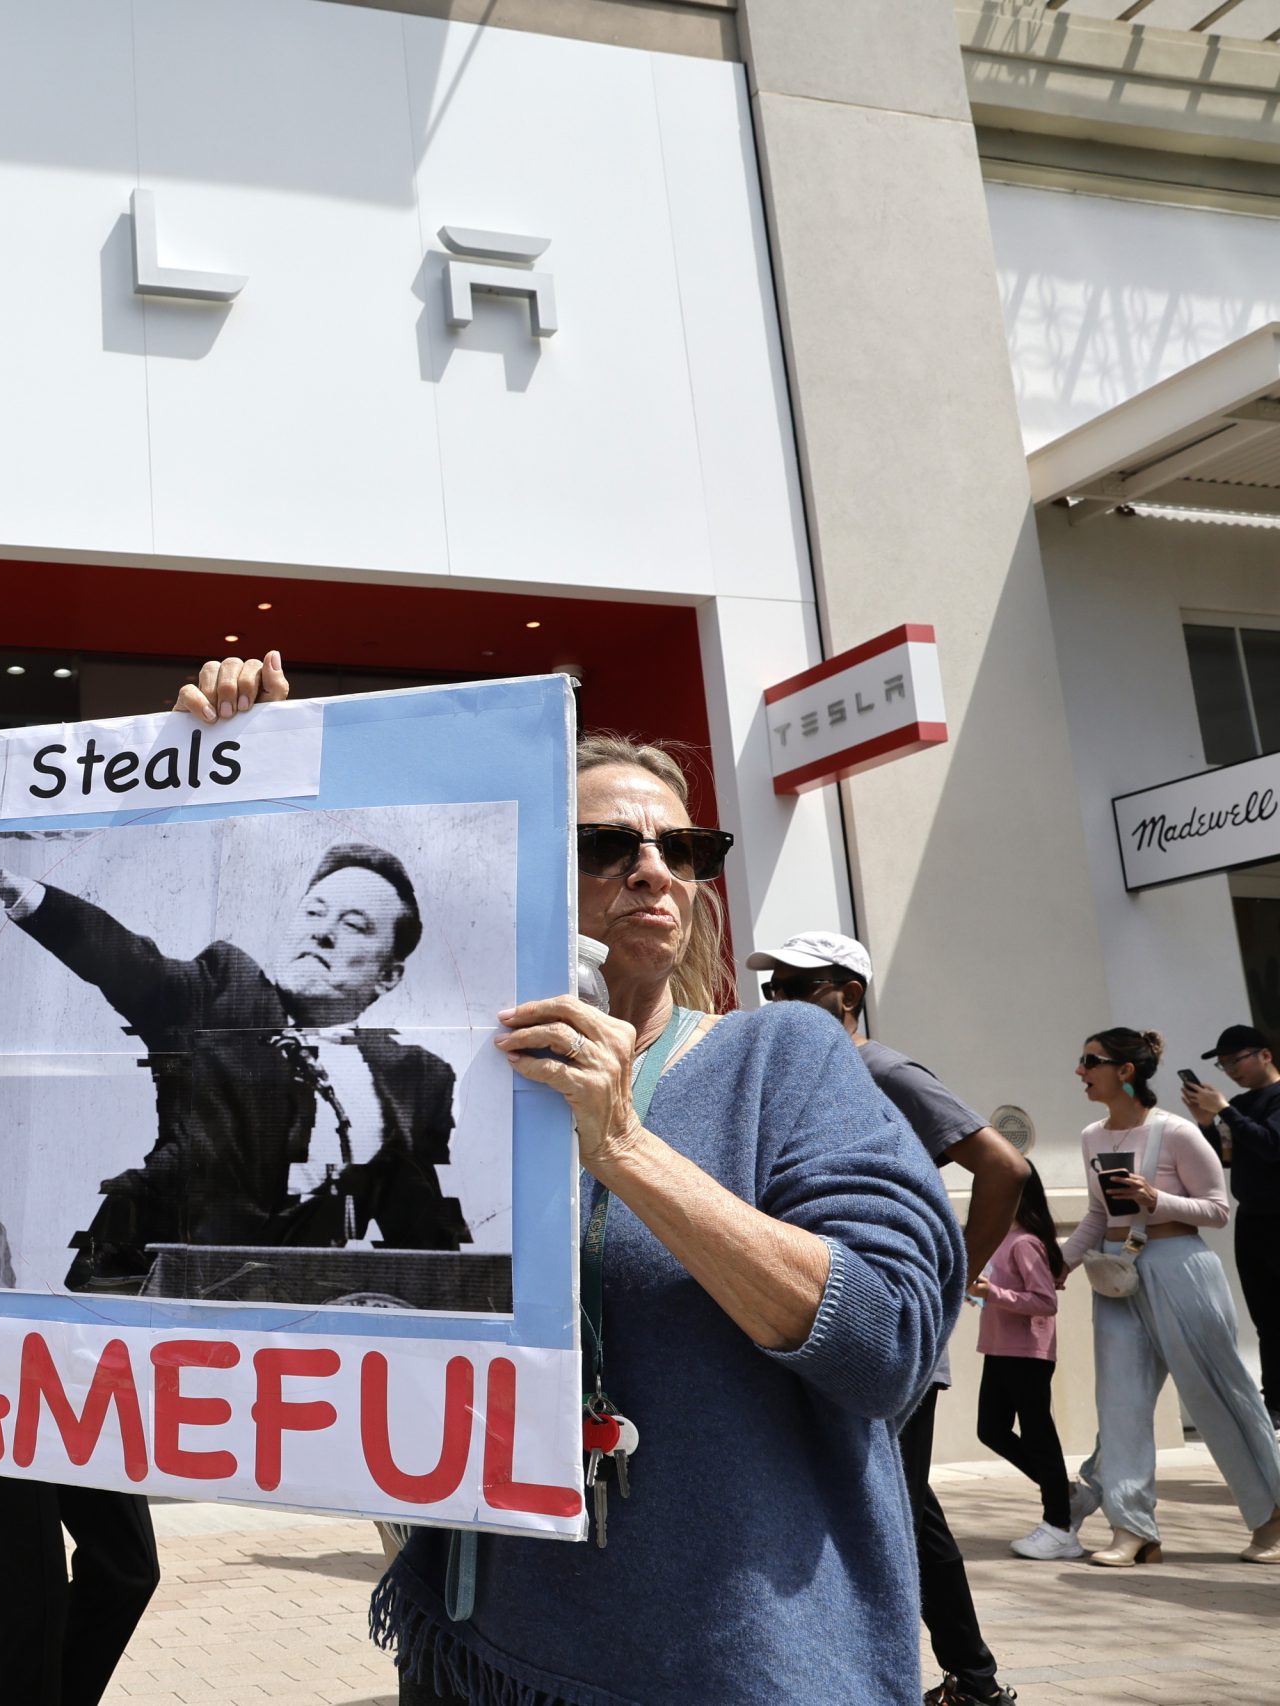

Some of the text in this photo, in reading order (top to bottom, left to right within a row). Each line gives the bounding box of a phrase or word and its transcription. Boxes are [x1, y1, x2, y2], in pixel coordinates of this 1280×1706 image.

[773, 674, 905, 747] TESLA
[28, 728, 242, 799] Steals
[1131, 788, 1278, 853] Madewell
